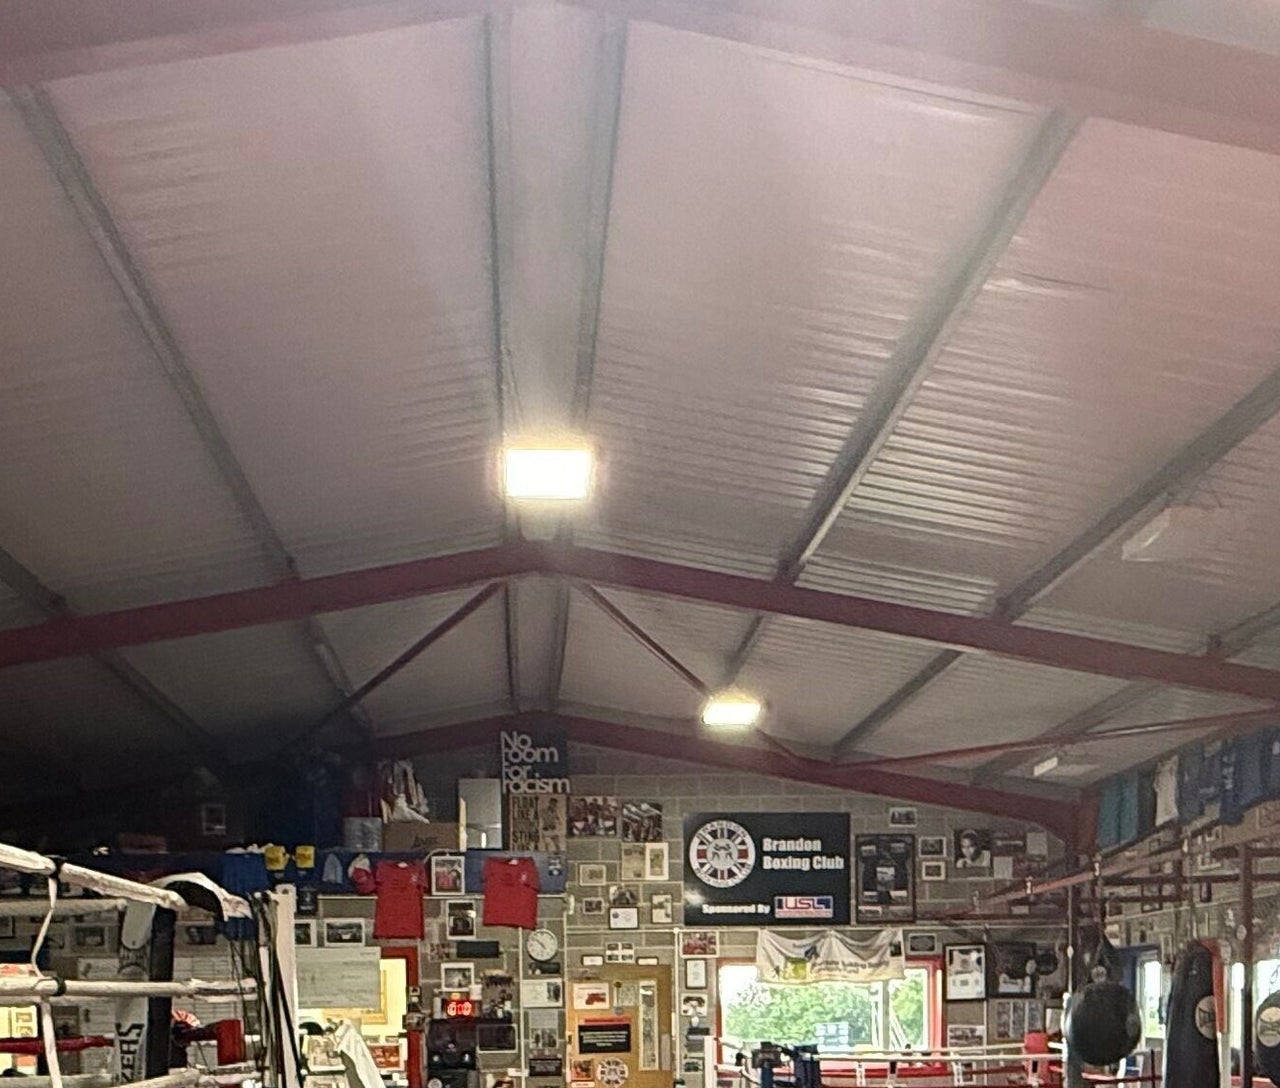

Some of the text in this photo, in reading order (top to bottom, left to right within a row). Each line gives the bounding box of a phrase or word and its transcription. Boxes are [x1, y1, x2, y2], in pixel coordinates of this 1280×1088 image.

[501, 730, 532, 748] No
[502, 747, 560, 763] room
[502, 761, 533, 780] for
[502, 773, 571, 794] racism
[762, 838, 822, 852] Brandon
[762, 856, 845, 871] Boxing Club
[702, 904, 755, 914] Sponsored
[757, 904, 771, 915] By
